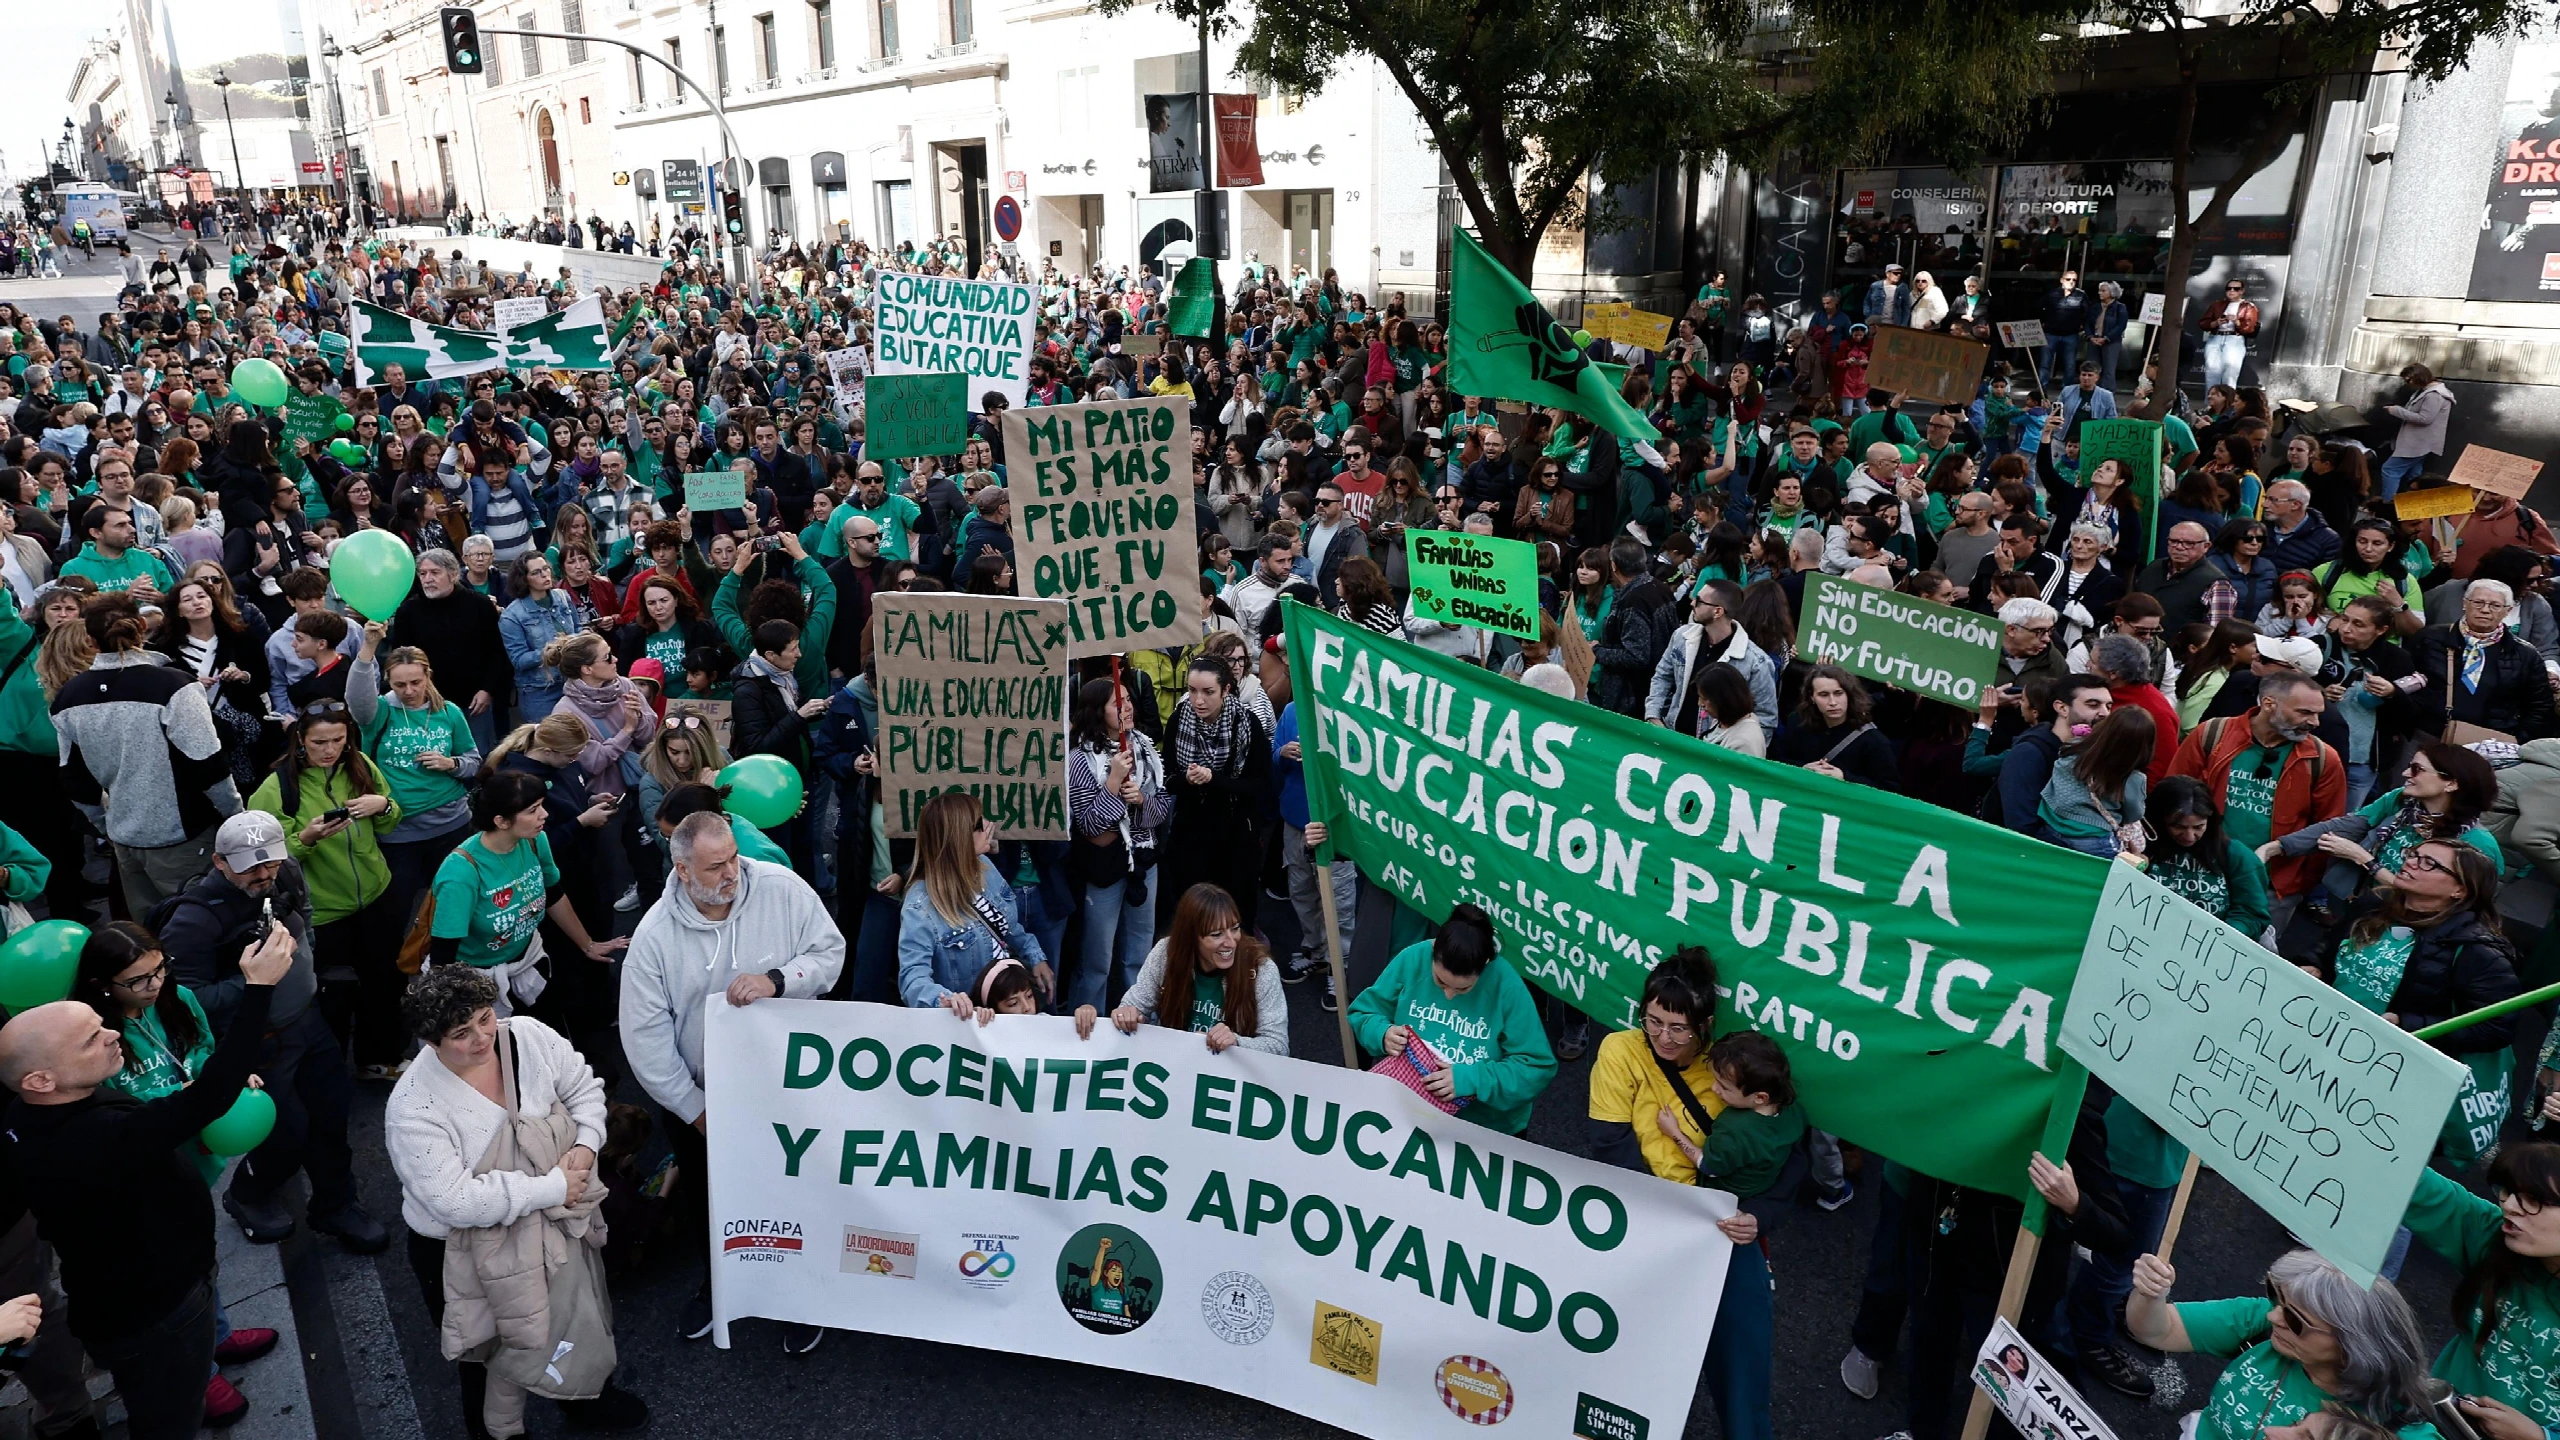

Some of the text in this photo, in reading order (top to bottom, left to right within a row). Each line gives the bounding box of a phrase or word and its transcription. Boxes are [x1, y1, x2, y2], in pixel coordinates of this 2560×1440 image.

[664, 162, 676, 178] P
[1153, 157, 1200, 174] YERMA
[1346, 190, 1360, 202] 29
[1891, 185, 1987, 200] CONSEJERÍA
[2005, 184, 2115, 198] DE CULTURA
[2019, 200, 2099, 214] DEPORTE
[880, 274, 1031, 316] COMUNIDAD
[878, 304, 1022, 348] EDUCATIVA
[880, 334, 1022, 380] BUTARQUE
[876, 428, 896, 449] LA
[1026, 414, 1074, 456] MI
[1036, 456, 1078, 498] ES
[1024, 488, 1179, 545] PEQUEÑO
[1034, 539, 1165, 598] QUE TU
[1429, 598, 1446, 614] LA
[1451, 598, 1532, 634] EDUCACIÓN
[1815, 605, 1858, 636] NO
[884, 609, 1046, 666] FAMILIAS
[882, 667, 1064, 722] UNA EDUCACIÓN
[889, 720, 1047, 780] PÚBLICA
[1311, 628, 1579, 790] FAMILIAS
[1615, 752, 1788, 864] CON
[1818, 813, 1960, 928] LA
[1312, 693, 2056, 1073] EDUCACIÓN PÚBLICA
[1382, 860, 1427, 905] AFA
[1522, 944, 1586, 1000] SAN
[2114, 977, 2152, 1022] YO
[2107, 924, 2150, 970] DE
[2157, 960, 2210, 1014] SUS
[2238, 1016, 2401, 1164] ALUMNOS,
[2088, 1011, 2346, 1230] SU ESCUELA
[783, 1031, 1629, 1253] DOCENTES EDUCANDO
[724, 1220, 803, 1236] CONFAPA
[771, 1122, 822, 1178] Y
[838, 1129, 1168, 1214] FAMILIAS
[1186, 1169, 1621, 1354] APOYANDO
[740, 1254, 784, 1264] MADRID
[846, 1234, 916, 1257] LA KOORDINADORA
[974, 1240, 1006, 1252] TEA
[1072, 1308, 1097, 1317] FAMILIAS
[1098, 1311, 1118, 1320] UNIDAS
[1324, 1312, 1351, 1320] FAMILIAS
[1354, 1317, 1364, 1328] DEL
[1339, 1367, 1357, 1376] LUCHA
[1451, 1372, 1498, 1392] COMEDOR
[1447, 1378, 1502, 1400] UNIVERSAL
[2223, 1390, 2250, 1416] DE
[1586, 1416, 1604, 1430] SIN
[1588, 1406, 1637, 1435] APRENDER
[2020, 1424, 2036, 1439] ME
